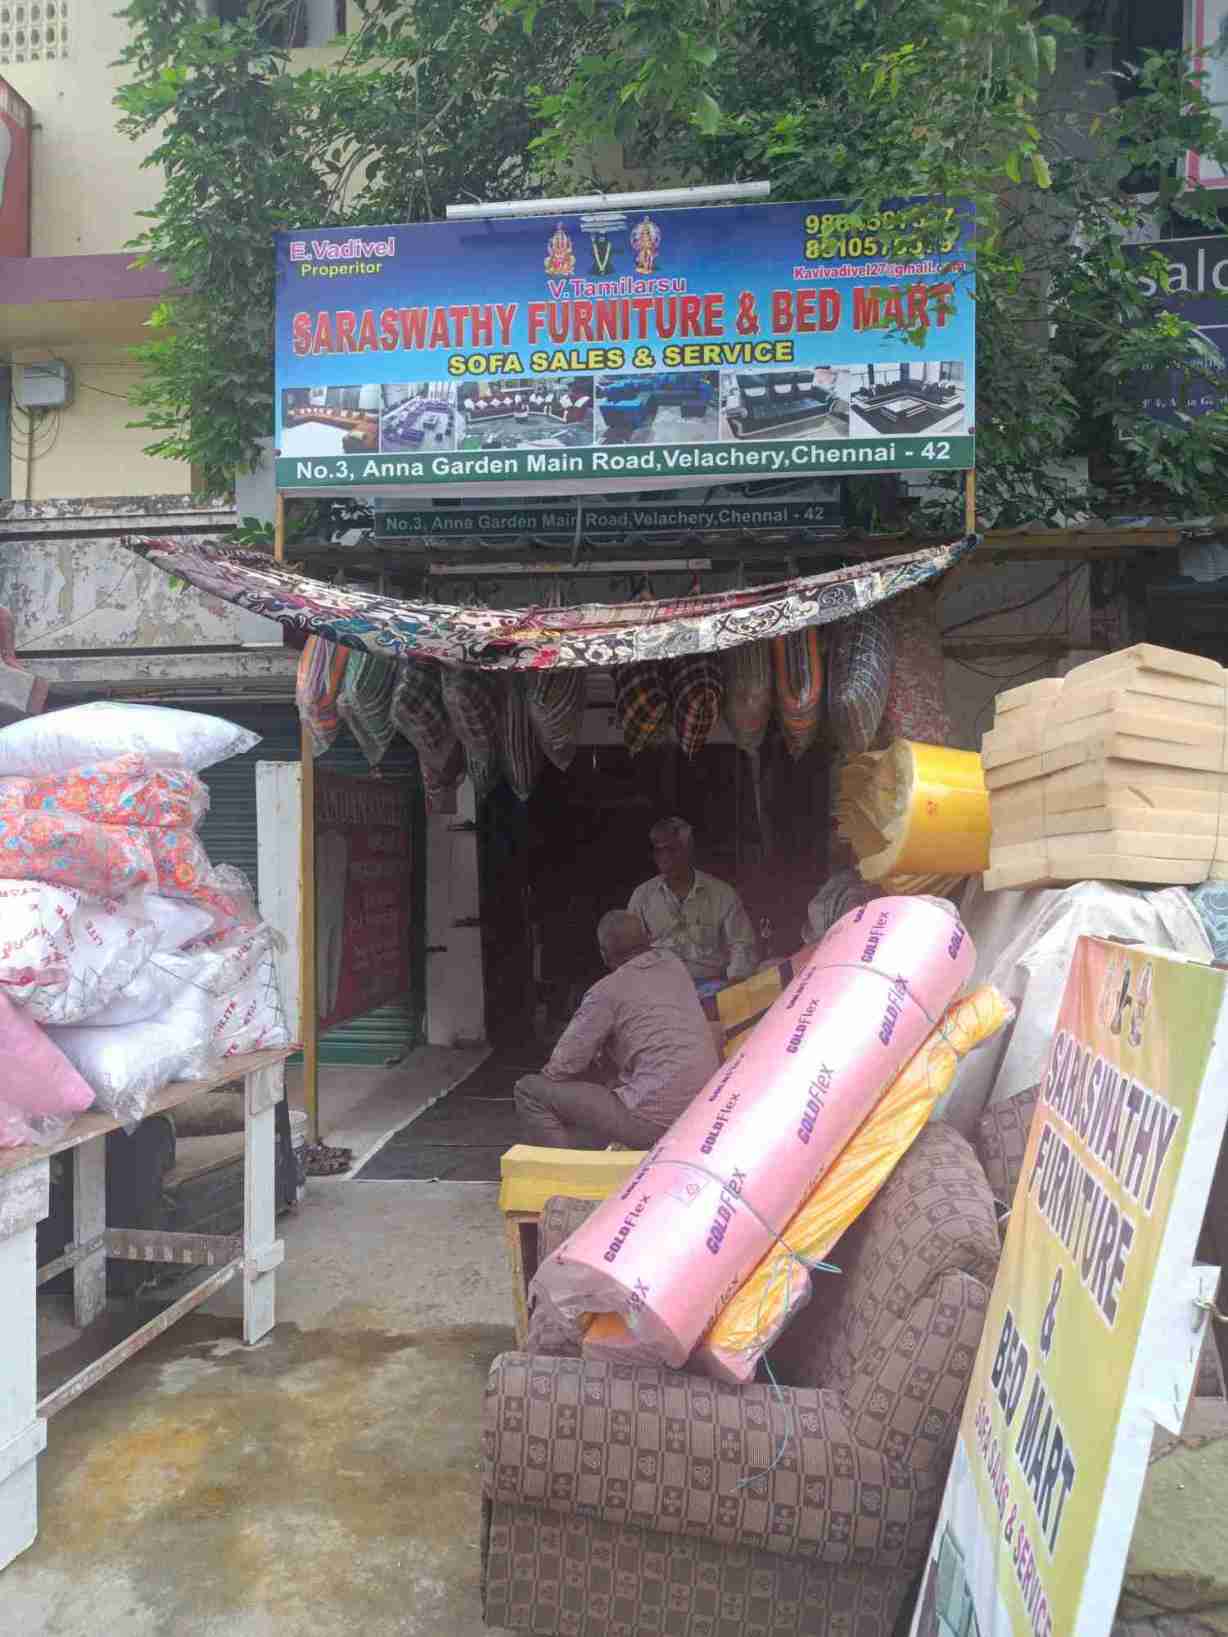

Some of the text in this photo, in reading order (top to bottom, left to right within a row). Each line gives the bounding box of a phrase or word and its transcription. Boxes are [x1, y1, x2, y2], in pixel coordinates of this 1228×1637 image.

[292, 282, 955, 356] SARASWATHY FURNITURE & BED MART
[547, 276, 688, 299] V.Tamilarsu
[448, 341, 794, 377] SOFA SALES & SERVICE
[296, 461, 354, 480] No.3,
[363, 458, 424, 478] Anna
[431, 453, 518, 475] Garden
[527, 451, 584, 472] Main
[921, 441, 951, 461] 42
[478, 513, 537, 529] Garden
[804, 507, 825, 522] 42
[1045, 1030, 1181, 1215] SARASWATHY
[1029, 1123, 1135, 1329] FURNITURE
[1039, 1265, 1063, 1359] &
[991, 1308, 1076, 1556] BED MART
